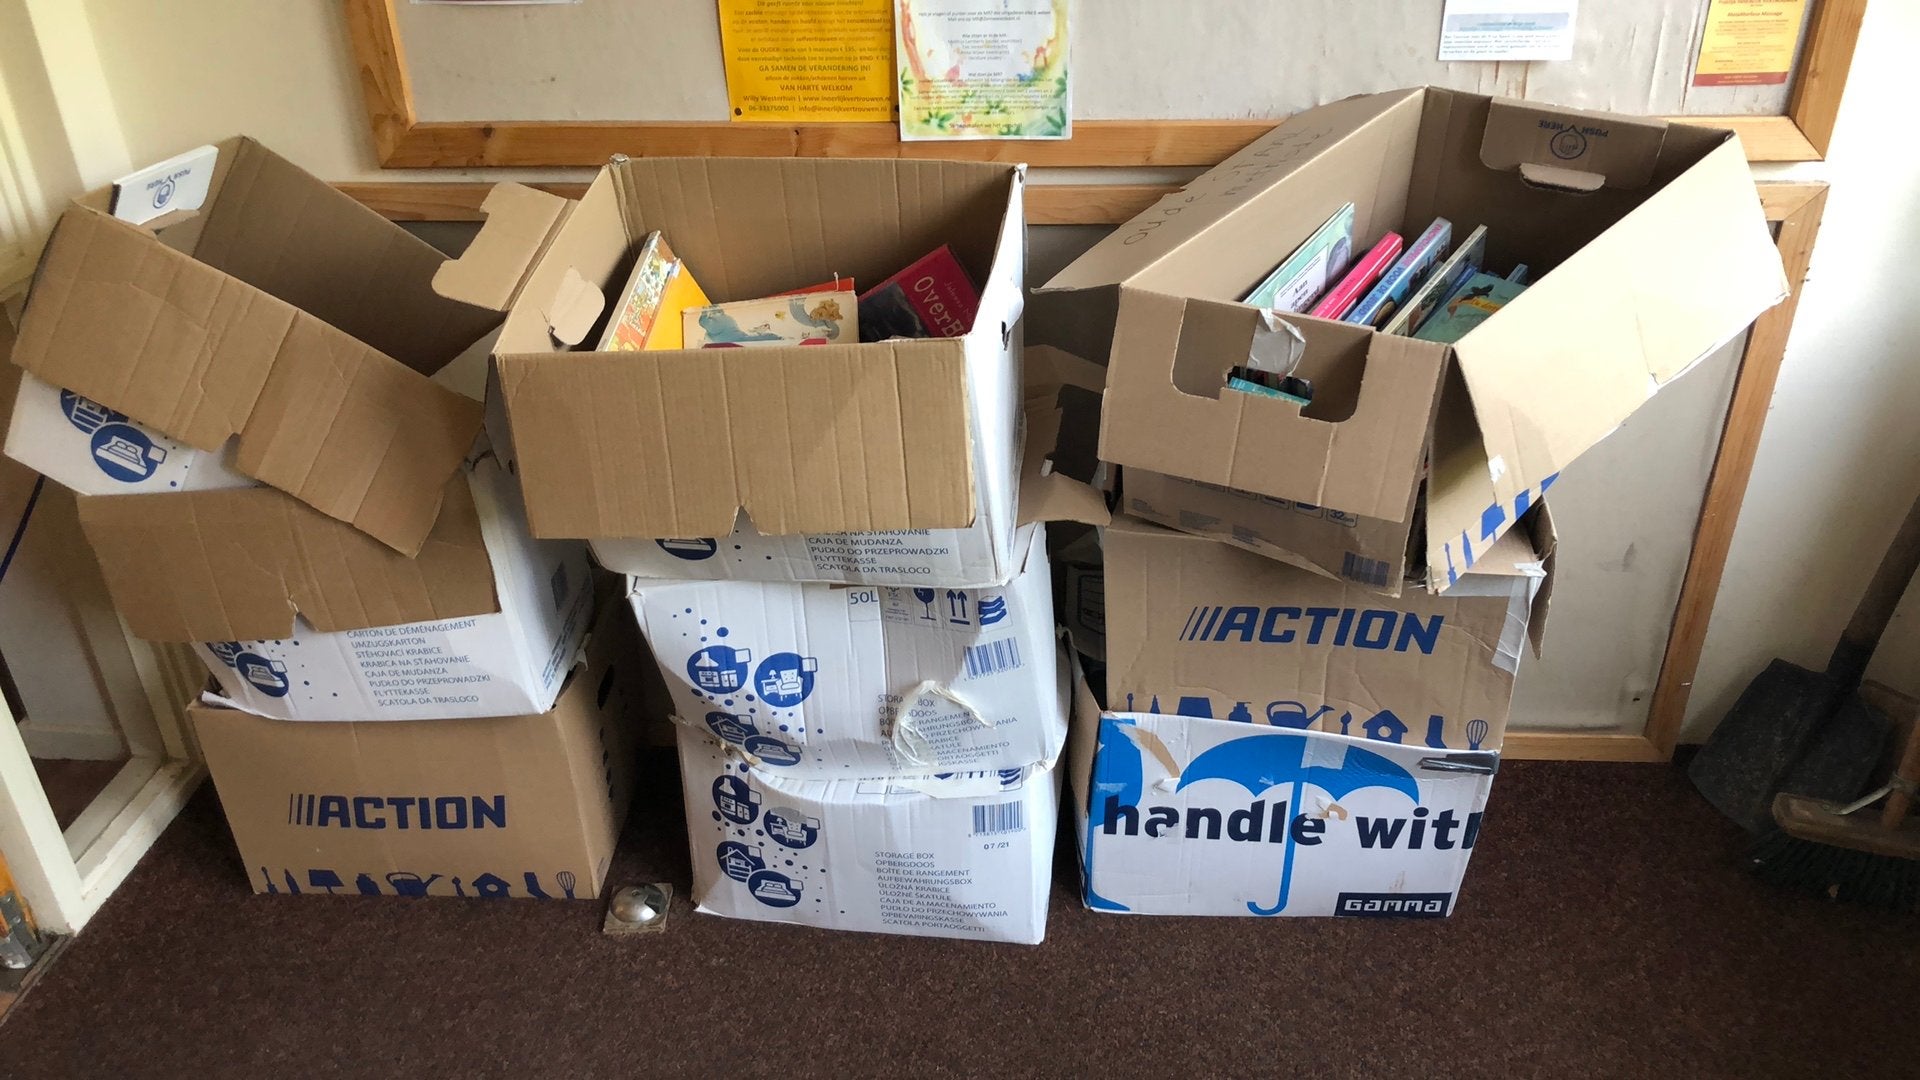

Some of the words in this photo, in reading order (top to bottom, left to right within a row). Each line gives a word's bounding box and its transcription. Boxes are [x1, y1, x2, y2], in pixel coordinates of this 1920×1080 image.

[1538, 120, 1564, 130] HERE
[1582, 126, 1609, 137] PUSH
[1387, 266, 1406, 286] VOOR
[1358, 293, 1379, 315] JEUGD
[850, 538, 904, 546] MUDANZA
[864, 548, 949, 556] PRZEPROWADZKI
[814, 555, 877, 564] FLYTTEKASSE
[816, 564, 860, 573] SCATOLA
[879, 566, 931, 574] TRASLOCO
[850, 590, 879, 605] 50L
[346, 630, 384, 638] CARTON
[1213, 606, 1445, 655] ACTION
[351, 637, 426, 649] UMZUGSKARTON
[406, 646, 443, 656] KRABICE
[360, 660, 398, 668] KRABICA
[399, 659, 412, 667] NA
[364, 670, 387, 678] CAJA
[402, 667, 448, 676] MUDANZA
[416, 674, 490, 686] PRZEPROWADZKI
[374, 688, 430, 698] FLYTTEKASSE
[378, 697, 418, 707] SCATOLA
[418, 697, 432, 705] DA
[433, 695, 479, 704] TRASLOCO
[918, 711, 971, 726] RANGEMEN
[318, 795, 506, 830] ACTION
[1103, 796, 1326, 846] handle
[874, 852, 914, 860] STORAGE
[875, 860, 935, 868] OPBERGDOOS
[878, 875, 973, 885] AUFBEWAHRUNGSBOX
[915, 886, 951, 894] KRABICE
[880, 897, 901, 905] CAJA
[916, 900, 997, 910] ALMACENAMIENTO
[926, 908, 1008, 918] PRZECHOWYWANIA
[882, 918, 920, 927] SCATOLA
[922, 920, 985, 932] PORTAOGGETTI
